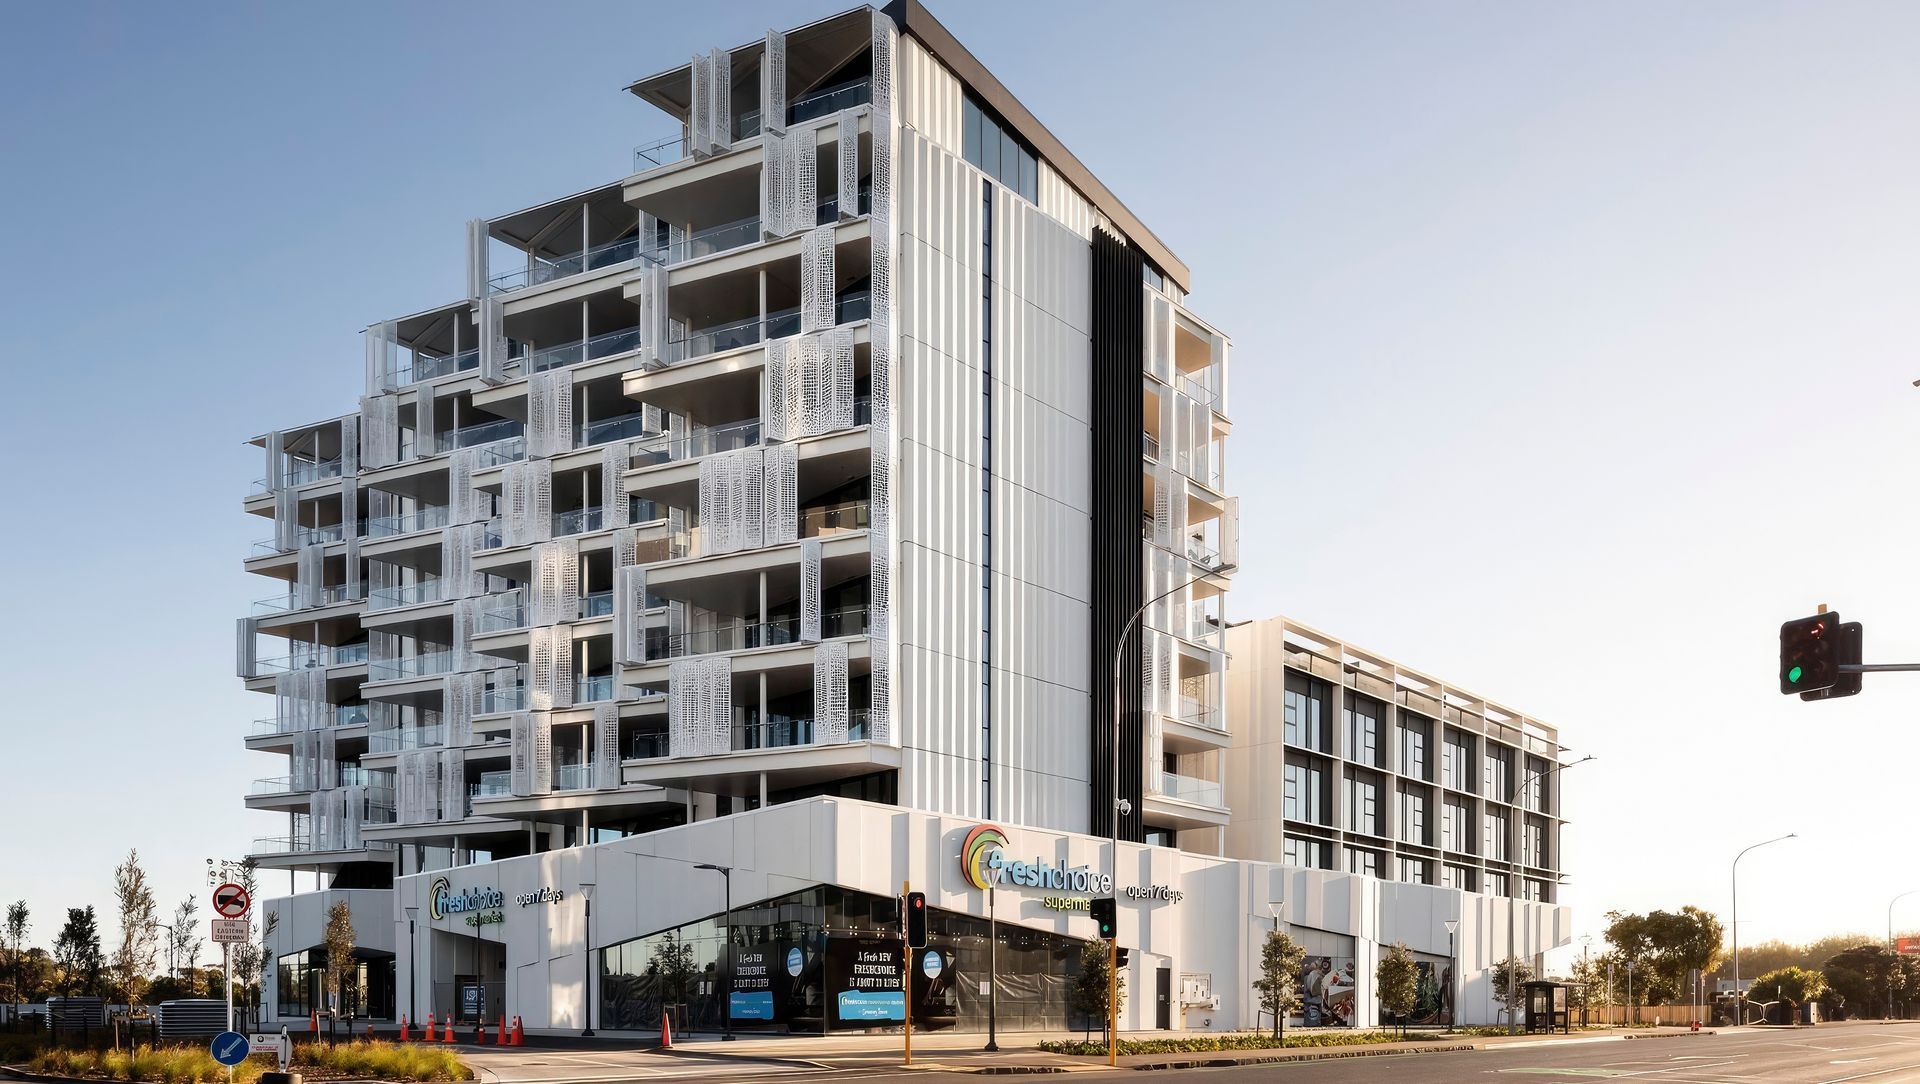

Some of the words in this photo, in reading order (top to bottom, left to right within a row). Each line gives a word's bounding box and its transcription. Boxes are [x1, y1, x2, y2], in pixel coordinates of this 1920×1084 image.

[515, 893, 535, 908] open
[543, 886, 564, 904] days
[1126, 885, 1151, 901] open
[1161, 885, 1184, 905] days
